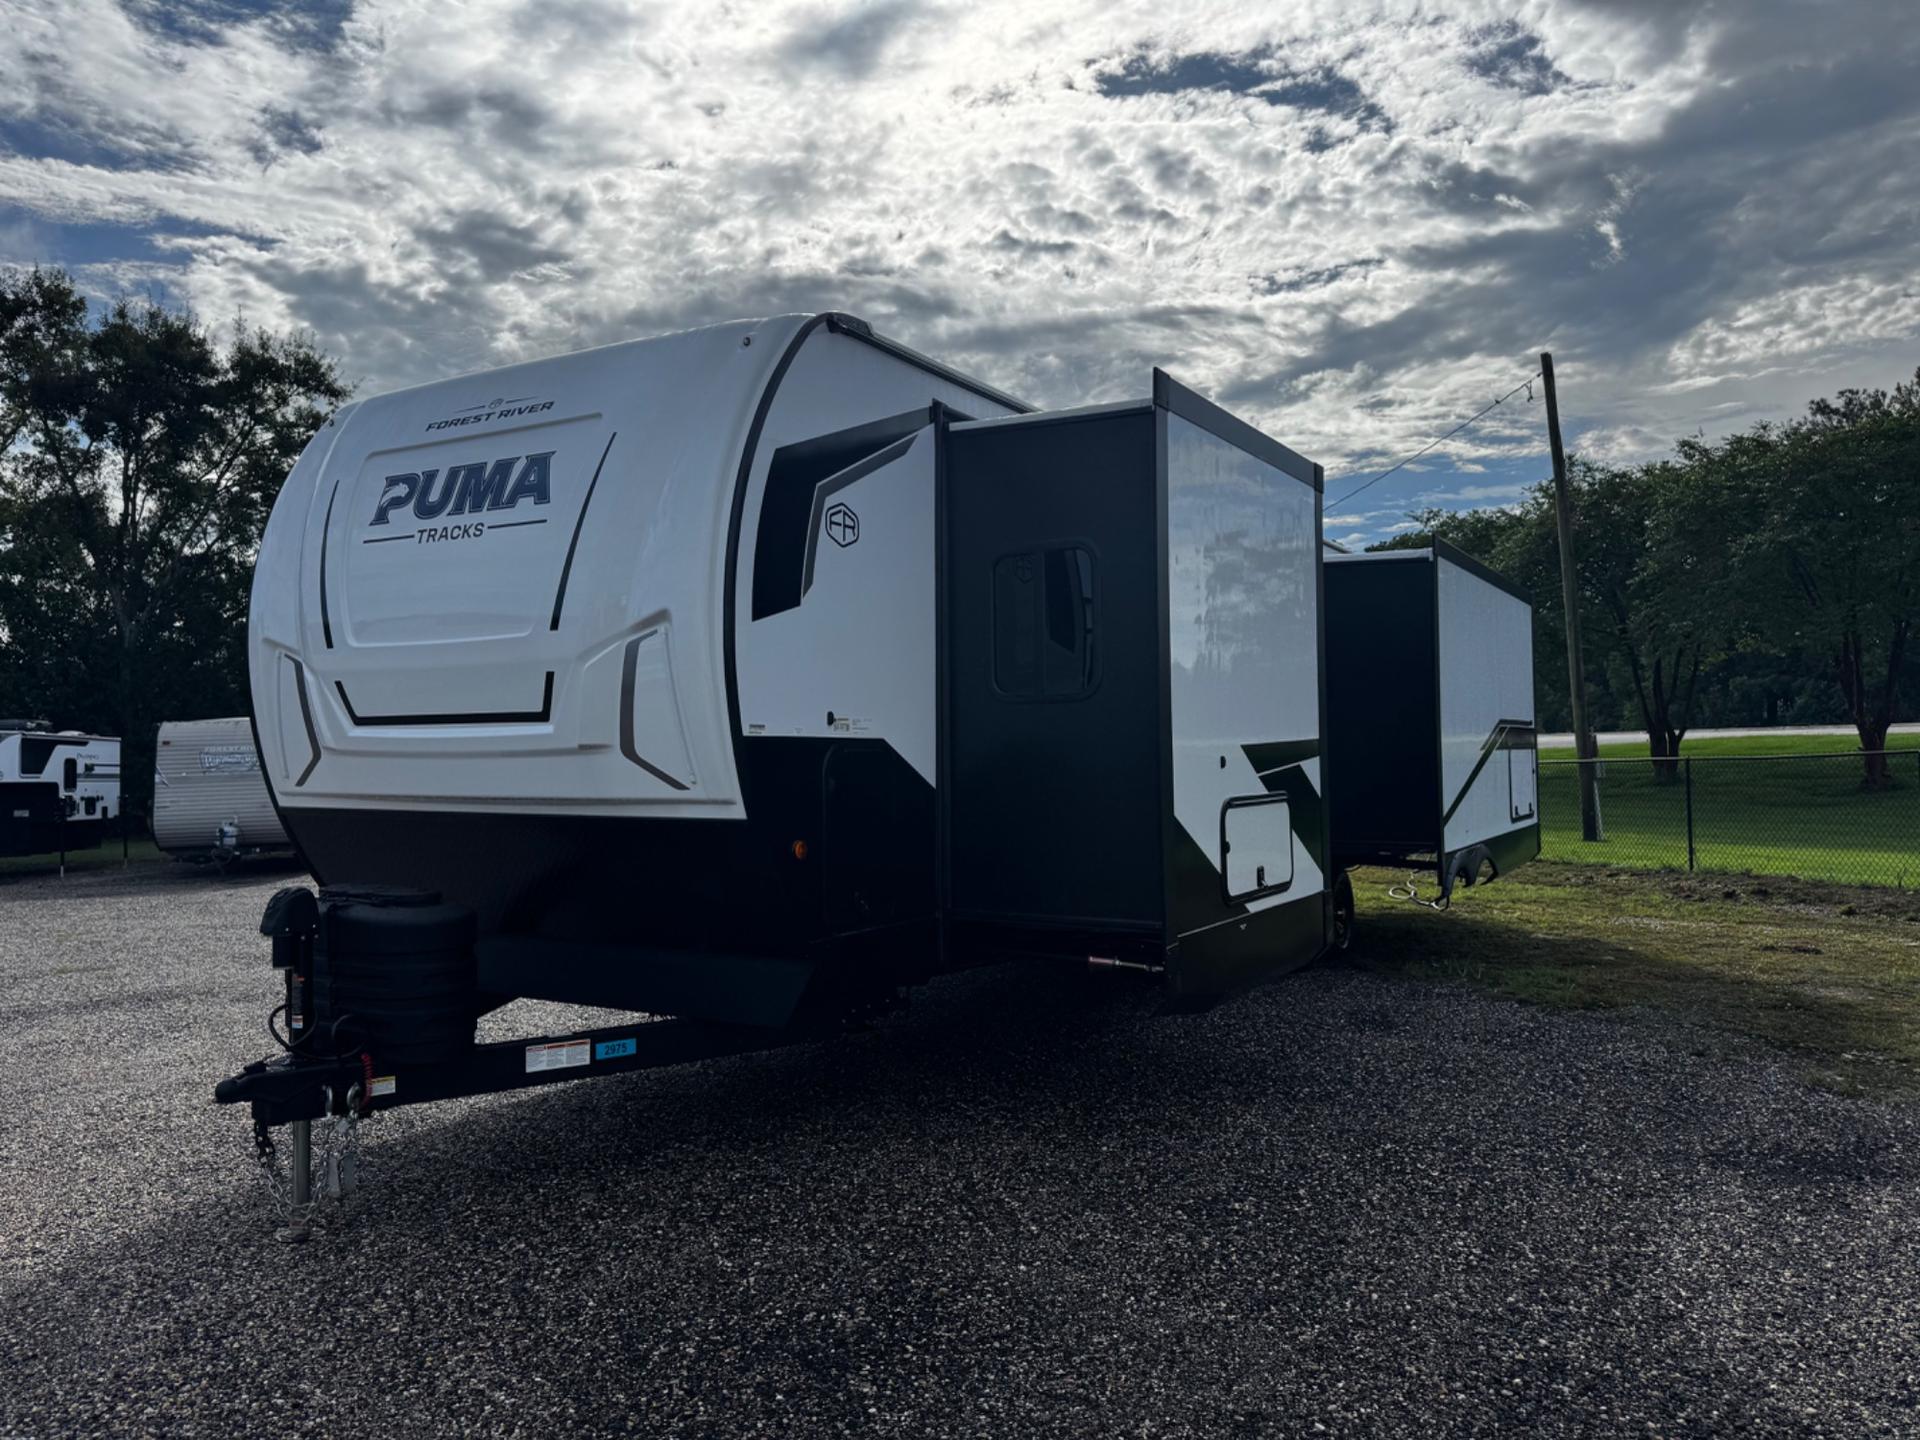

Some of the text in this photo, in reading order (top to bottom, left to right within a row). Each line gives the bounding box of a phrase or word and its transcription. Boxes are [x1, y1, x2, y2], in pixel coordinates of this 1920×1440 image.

[425, 411, 496, 432] FOREST
[497, 401, 555, 420] RIVER
[368, 450, 557, 526] PUMA
[417, 522, 485, 544] TRACKS
[604, 1042, 628, 1056] 2975
